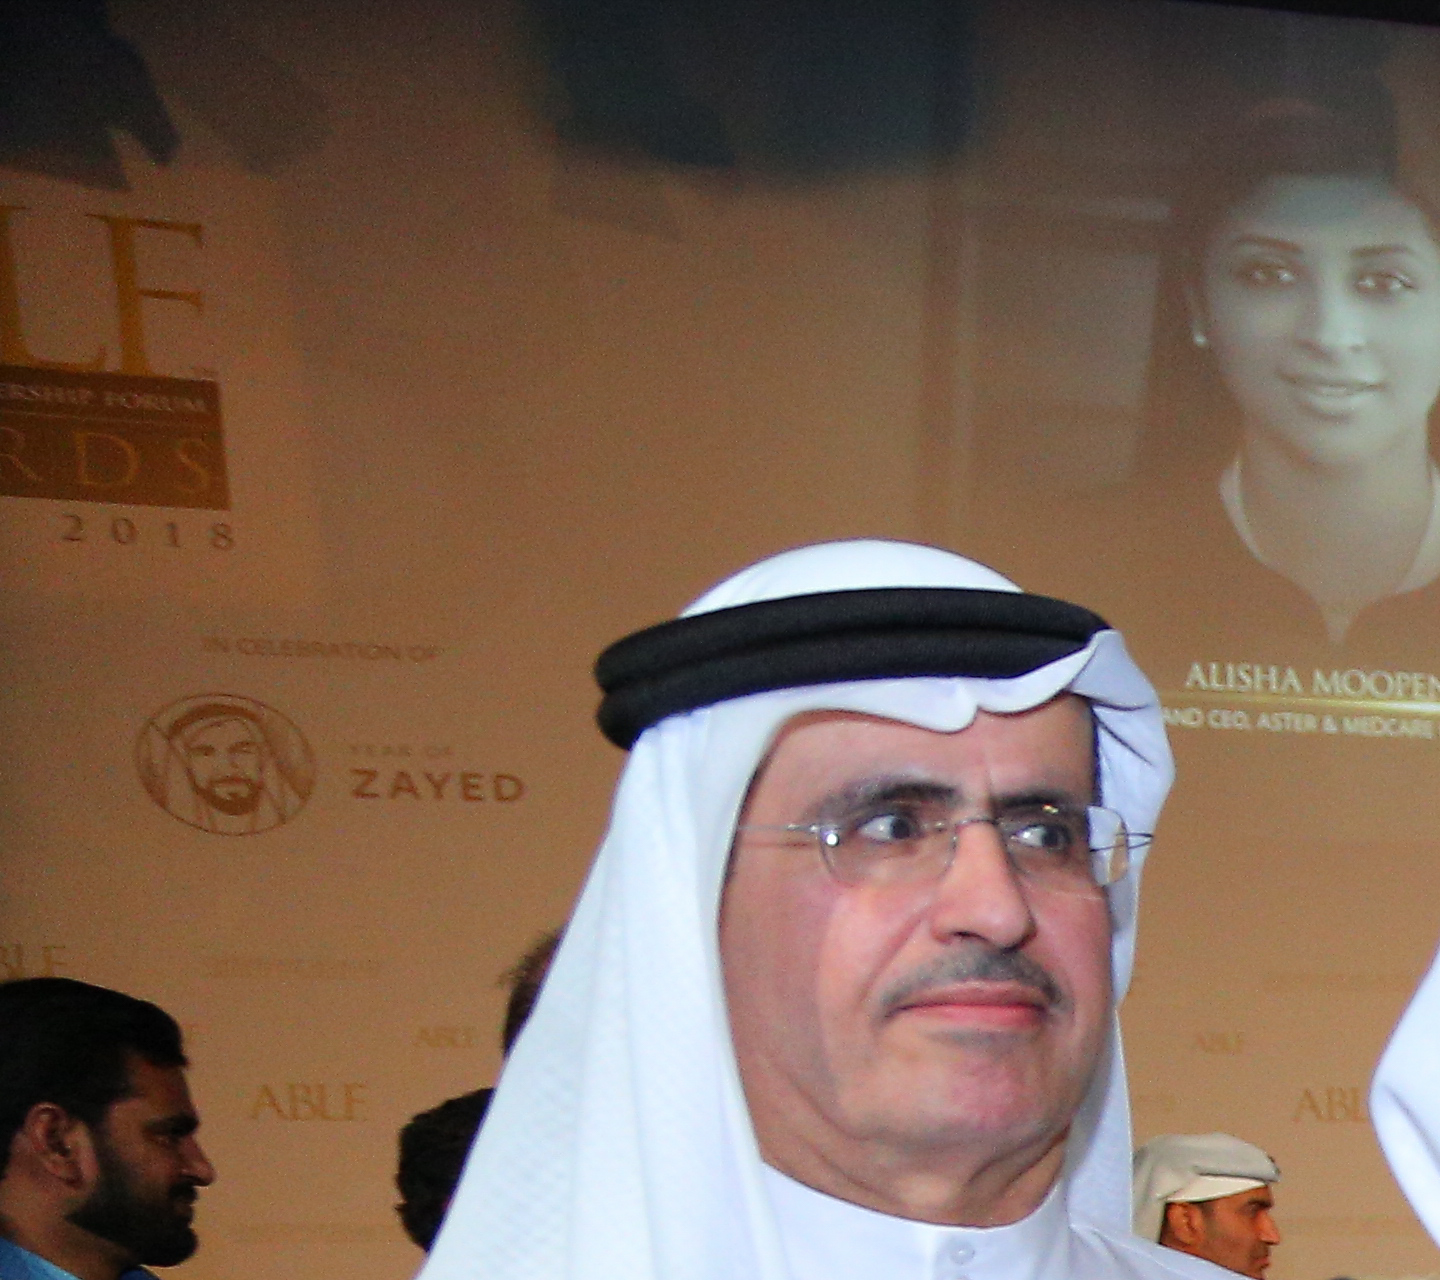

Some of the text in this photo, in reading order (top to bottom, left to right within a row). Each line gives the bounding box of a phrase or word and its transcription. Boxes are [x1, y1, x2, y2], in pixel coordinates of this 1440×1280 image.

[59, 512, 237, 552] 2018
[236, 637, 401, 662] CELEBRATION
[1184, 661, 1303, 694] ALISHA
[1256, 711, 1318, 734] ASTER
[1322, 715, 1339, 735] &
[1342, 716, 1434, 739] MEDCARE
[348, 767, 528, 805] ZAYED
